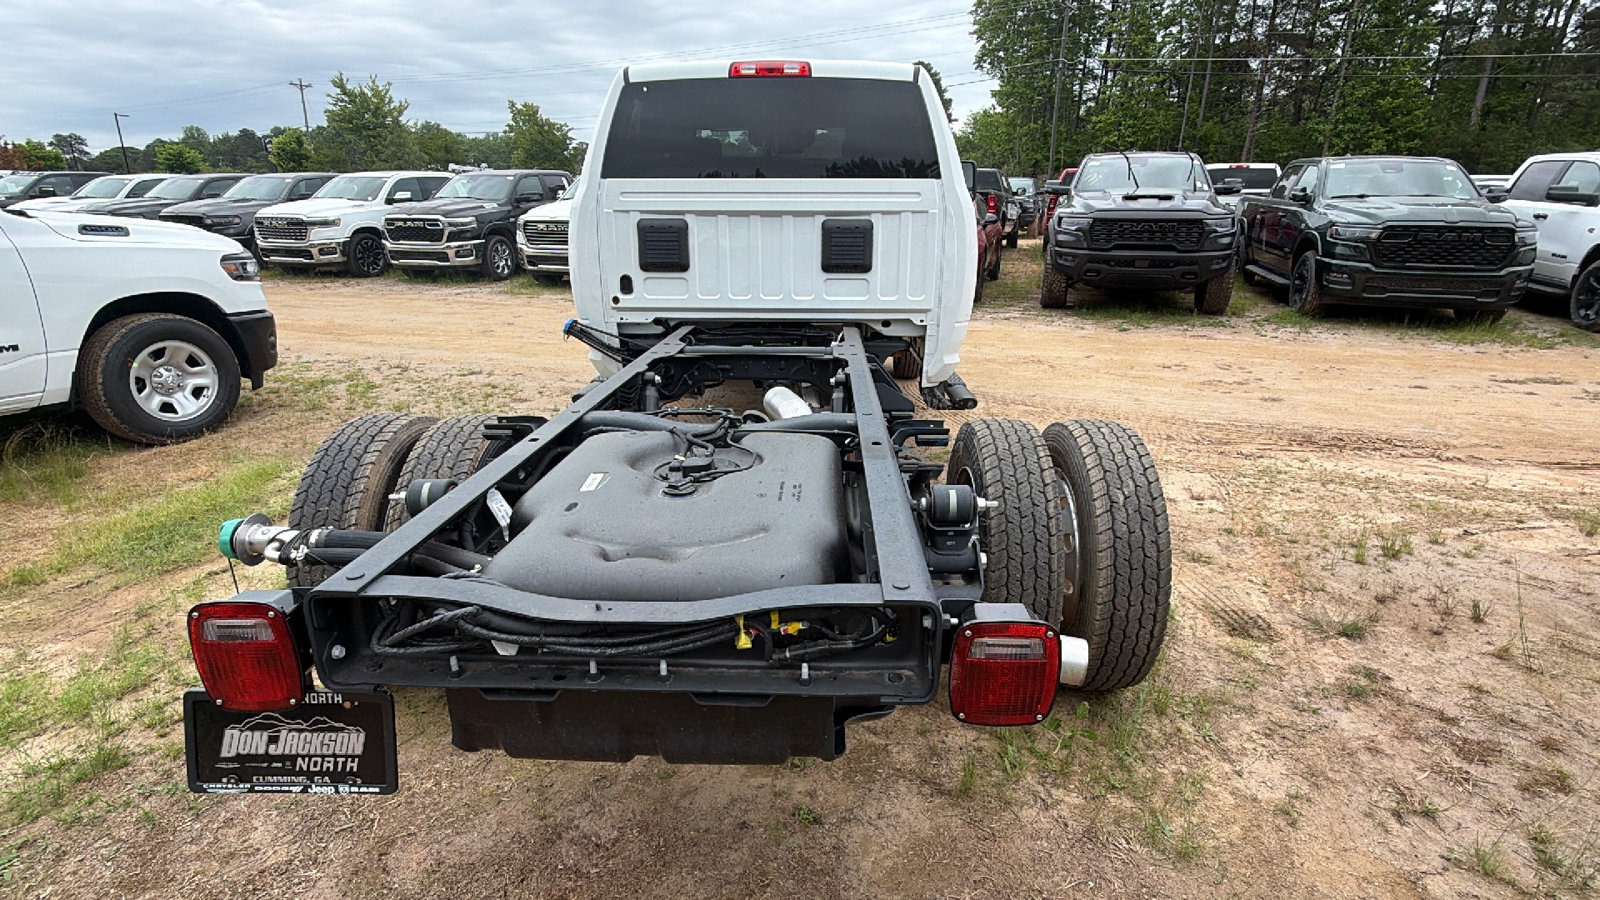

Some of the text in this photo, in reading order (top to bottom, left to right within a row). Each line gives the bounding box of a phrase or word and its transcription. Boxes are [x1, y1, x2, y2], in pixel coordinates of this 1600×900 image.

[1117, 222, 1177, 232] RAM
[1417, 232, 1482, 242] RAM
[220, 729, 366, 758] DON JACKSON
[295, 757, 359, 772] NORTH
[252, 775, 331, 784] CUMMING, GA
[308, 784, 335, 794] Jeep
